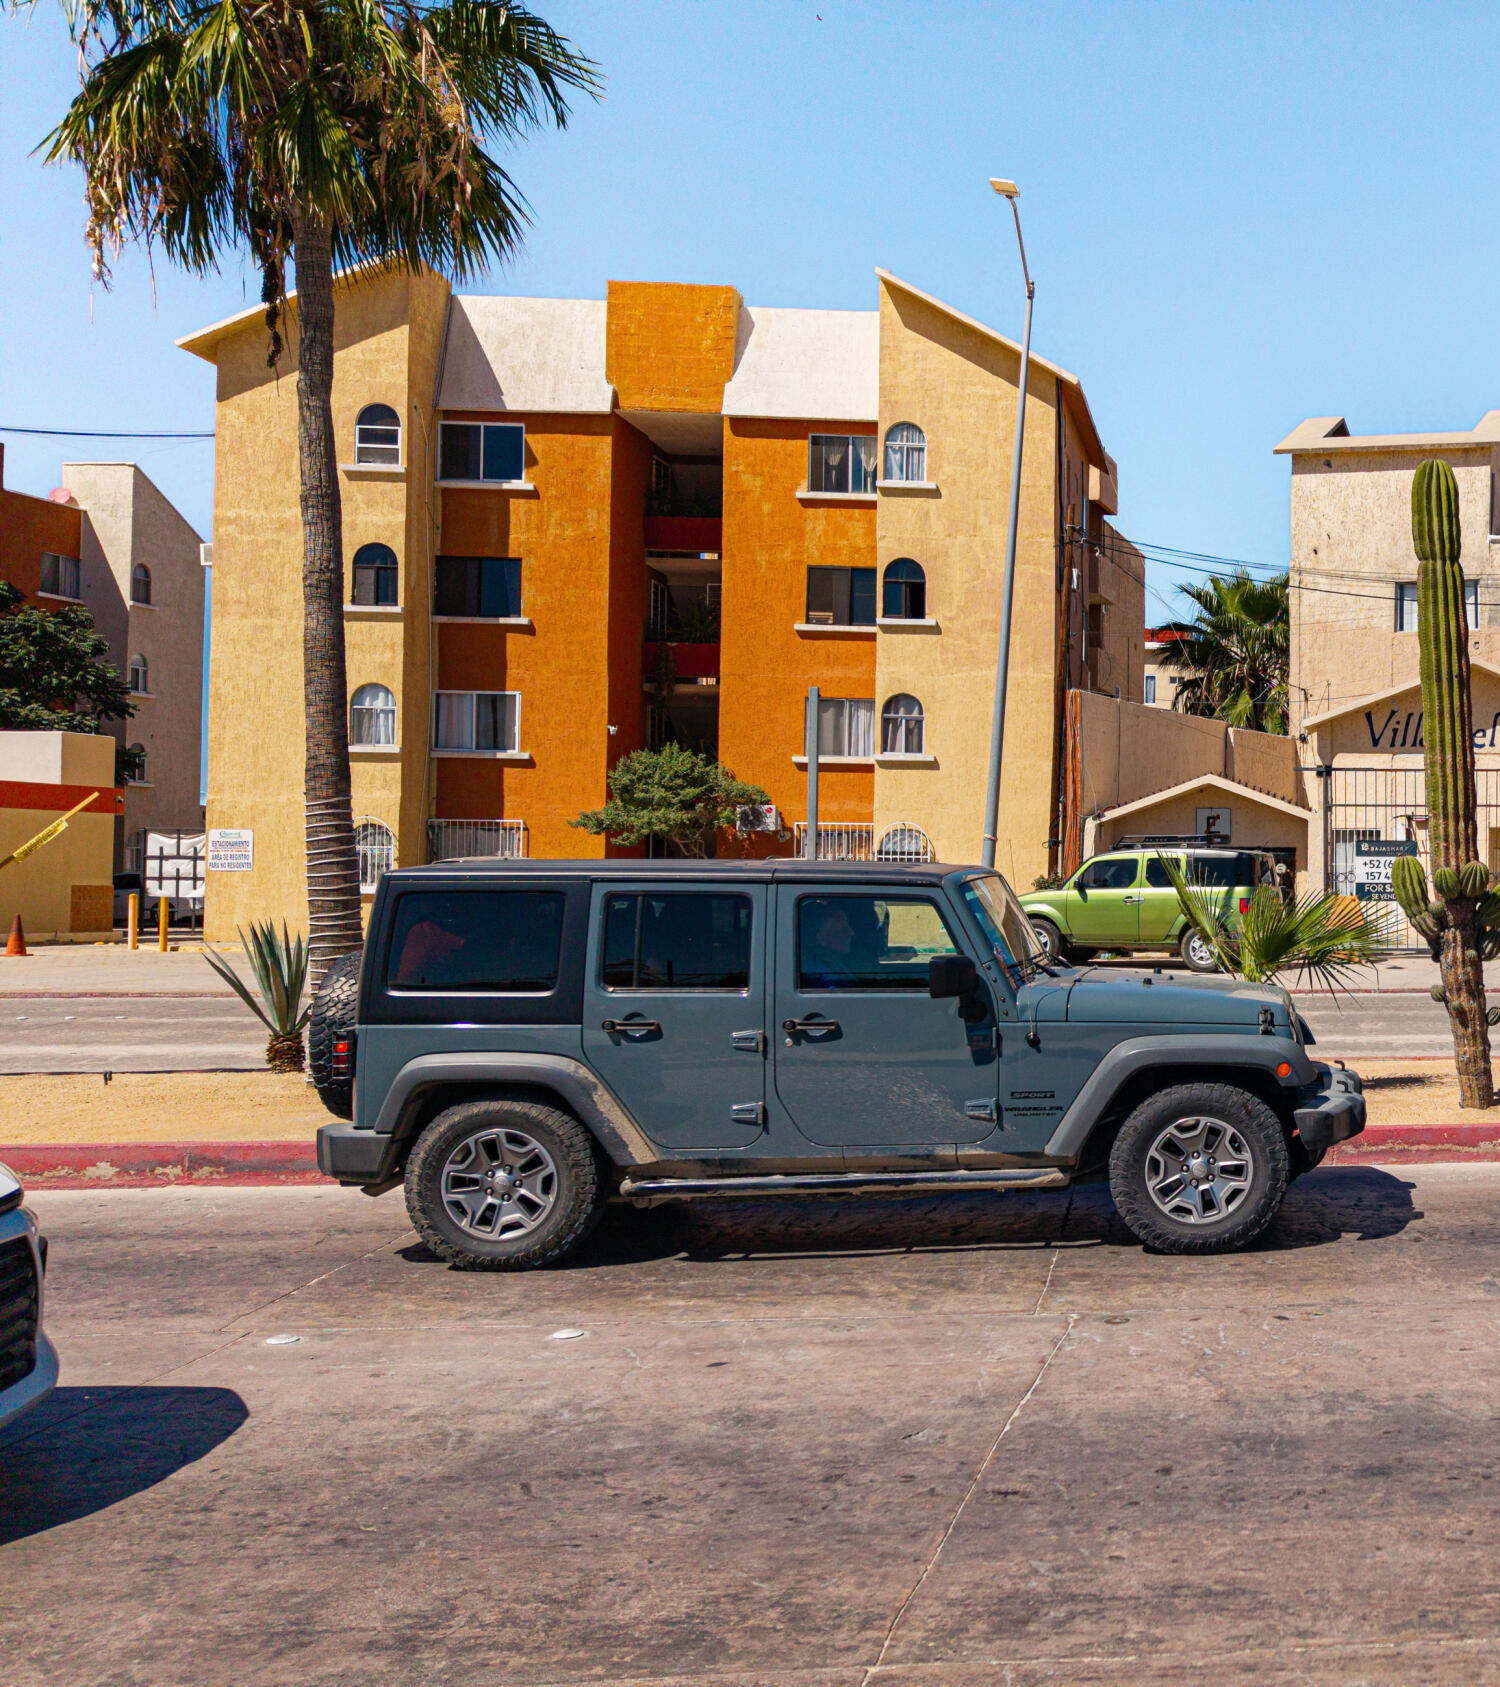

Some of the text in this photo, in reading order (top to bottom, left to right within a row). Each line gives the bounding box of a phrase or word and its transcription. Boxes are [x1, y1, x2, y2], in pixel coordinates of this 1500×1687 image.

[1365, 710, 1424, 748] Vill
[1473, 712, 1500, 748] el
[1362, 860, 1381, 869] +52
[1365, 872, 1381, 880] 157
[1364, 884, 1383, 892] FOR
[1011, 1091, 1055, 1099] SPORT
